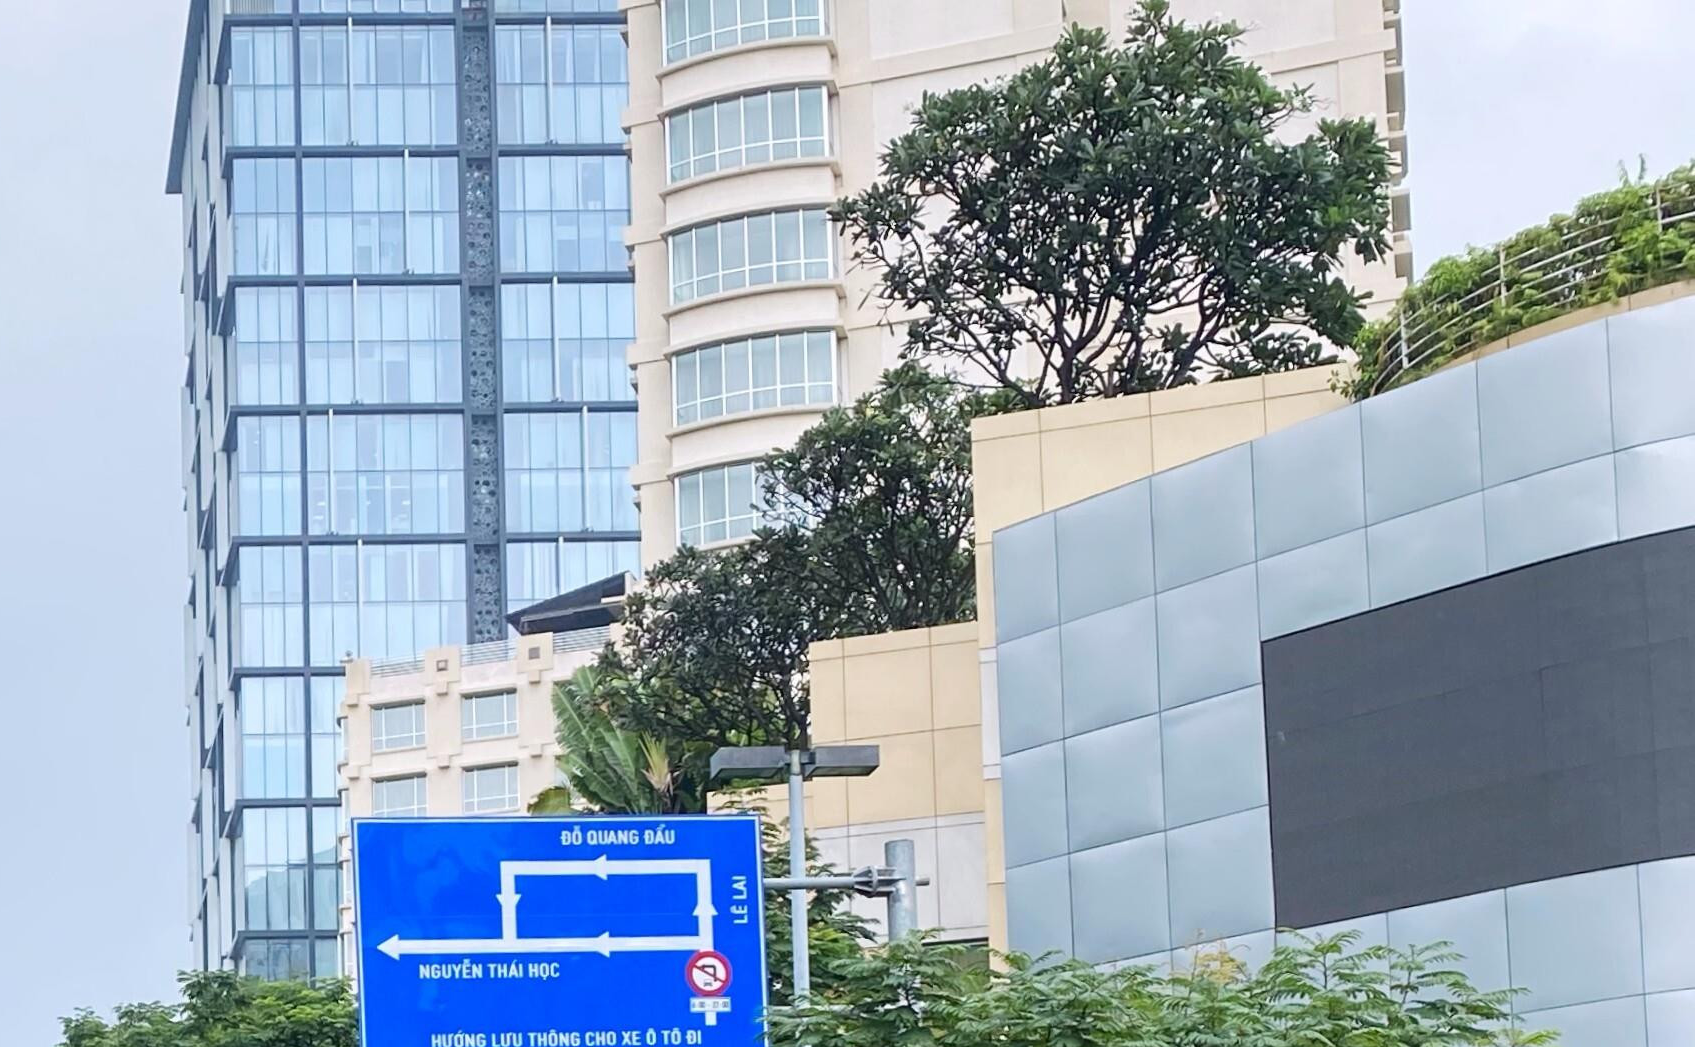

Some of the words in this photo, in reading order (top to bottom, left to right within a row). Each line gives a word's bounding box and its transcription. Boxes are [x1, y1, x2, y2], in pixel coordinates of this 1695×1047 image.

[560, 825, 582, 846] ĐỖ
[586, 829, 640, 846] QUANG
[731, 875, 748, 900] LAI
[729, 904, 748, 924] LÊ
[418, 958, 483, 979] NGUYỄN
[487, 958, 524, 979] THÁI
[528, 962, 560, 981] HỌC
[527, 1028, 581, 1047] THÔNG
[584, 1031, 617, 1047] CHO
[621, 1030, 642, 1046] XE
[645, 1028, 657, 1046] Ô
[660, 1027, 682, 1046] TÔ
[685, 1029, 702, 1046] ĐI
